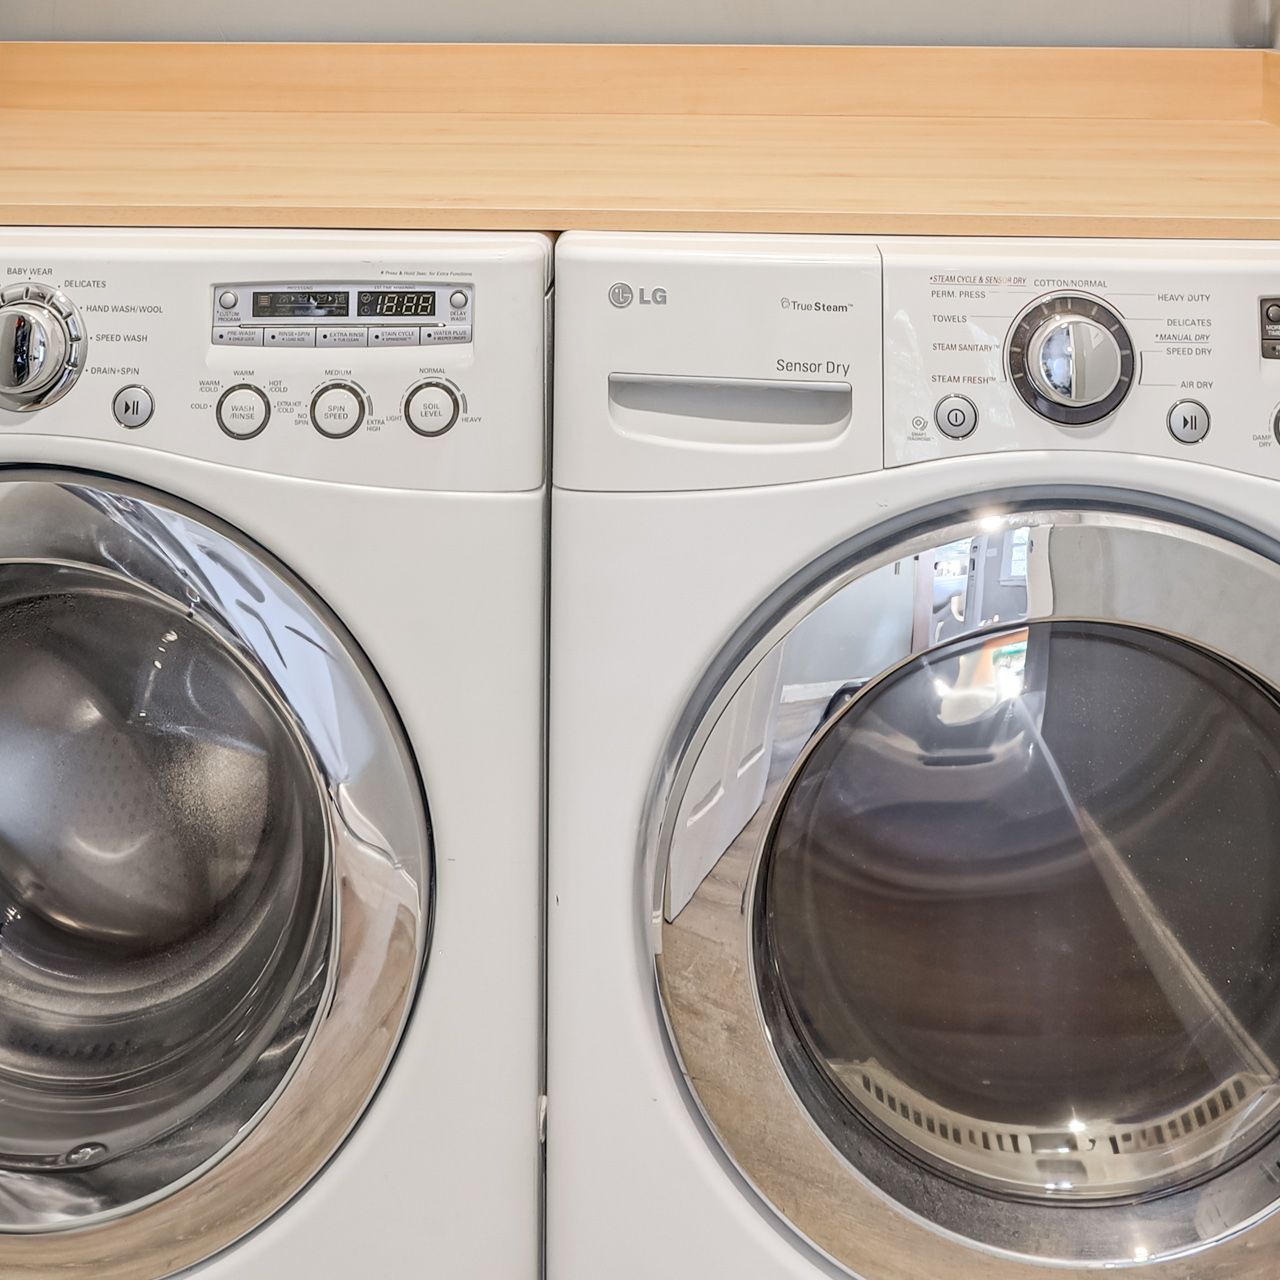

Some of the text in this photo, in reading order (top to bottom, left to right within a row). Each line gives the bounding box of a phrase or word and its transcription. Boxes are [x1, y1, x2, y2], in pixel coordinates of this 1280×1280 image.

[6, 267, 27, 275] BABY
[64, 280, 106, 288] DELICATES
[932, 275, 957, 283] STEAM
[956, 275, 977, 284] CYCLE
[978, 276, 984, 284] &
[1012, 276, 1026, 285] DRY
[1033, 279, 1108, 288] COTTON/NORMAL
[639, 287, 668, 305] LG
[931, 290, 986, 299] PERM. PRESS
[1157, 293, 1211, 302] HEAVY DUTY
[86, 304, 163, 314] HAND WASH/WOOL
[932, 314, 967, 323] TOWELS
[1166, 318, 1212, 327] DELICATES
[95, 334, 148, 342] SPEED WASH
[932, 343, 957, 351] STEAM
[1166, 347, 1212, 356] SPEED DRY
[776, 358, 850, 377] Sensor Dry
[931, 375, 961, 383] STEAM
[1180, 380, 1214, 389] AIR DRY
[324, 412, 349, 420] SPEED
